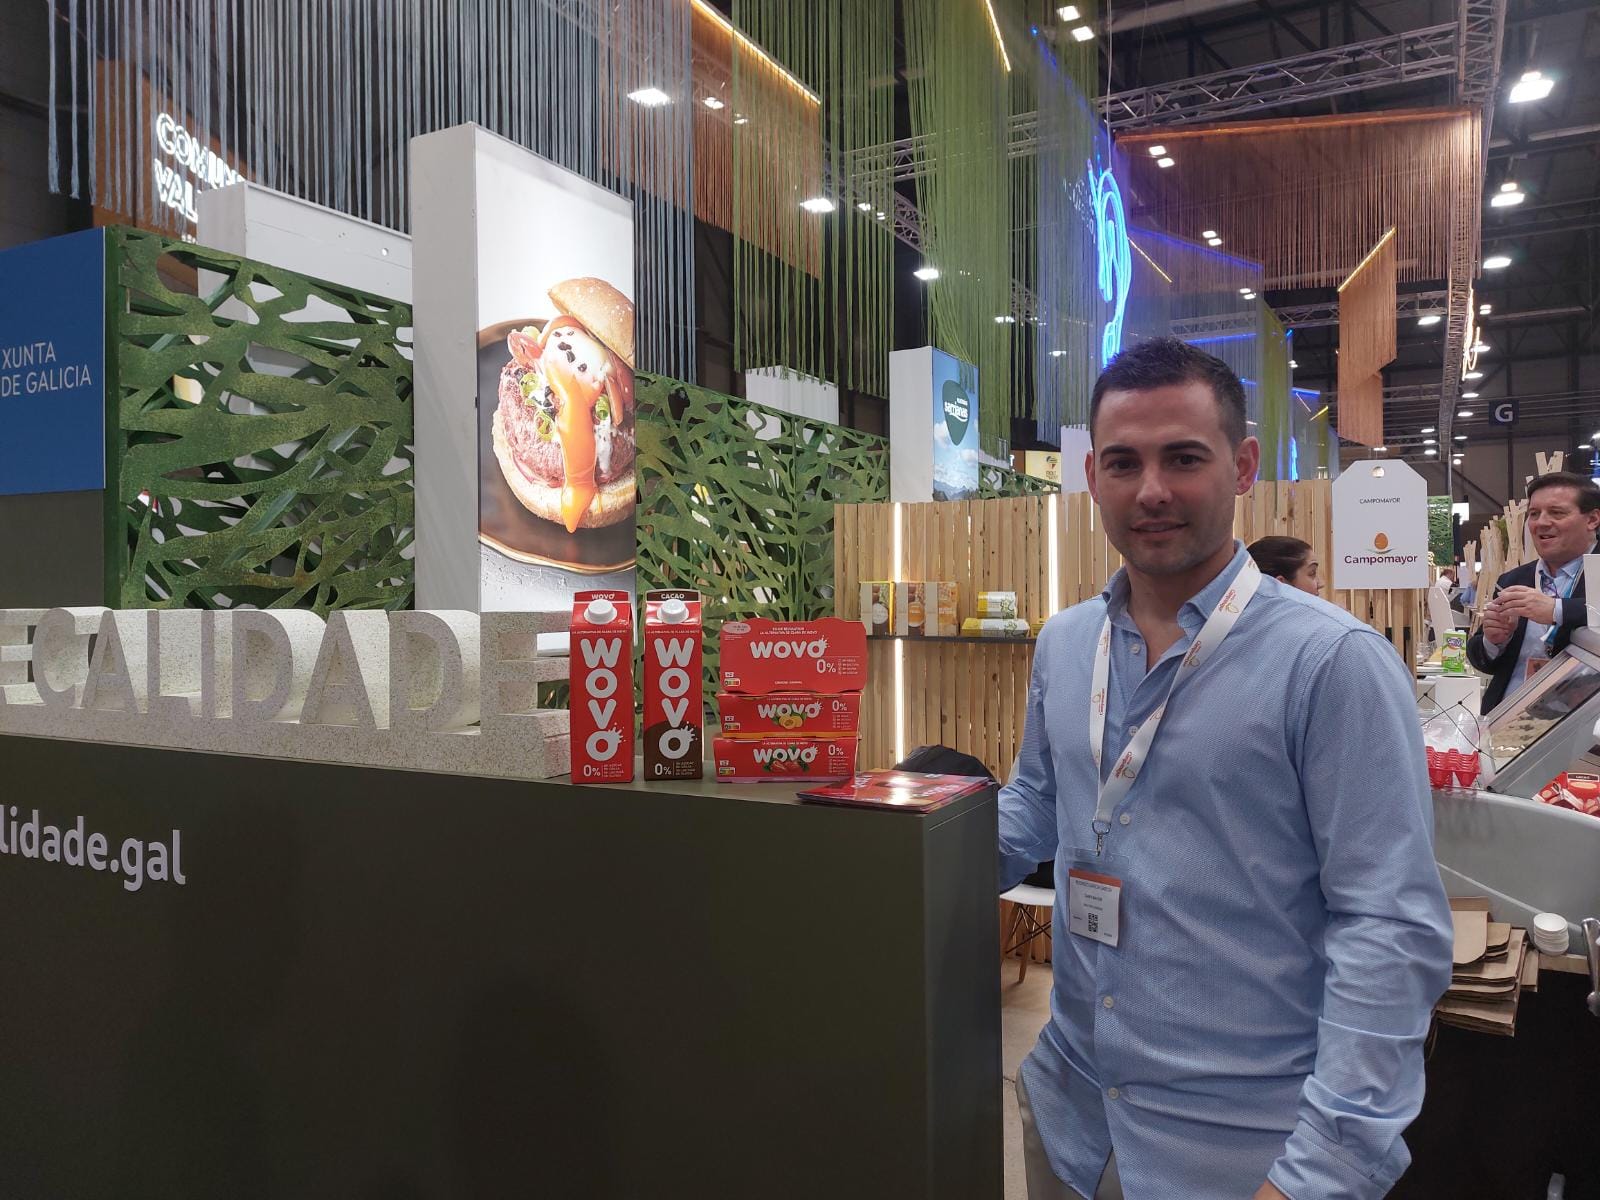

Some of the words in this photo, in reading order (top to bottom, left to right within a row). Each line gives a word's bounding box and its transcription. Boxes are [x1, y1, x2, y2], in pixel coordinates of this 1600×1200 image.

[2, 341, 57, 370] XUNTA
[1, 374, 22, 398] DE
[26, 364, 92, 394] GALICIA
[1494, 403, 1514, 423] G
[1359, 497, 1401, 505] CAMPOMAYOR
[1344, 554, 1418, 566] Campomayor
[660, 592, 685, 600] CACAO
[750, 637, 829, 659] WOVO
[757, 701, 822, 719] WOVO
[752, 746, 818, 764] WOVO
